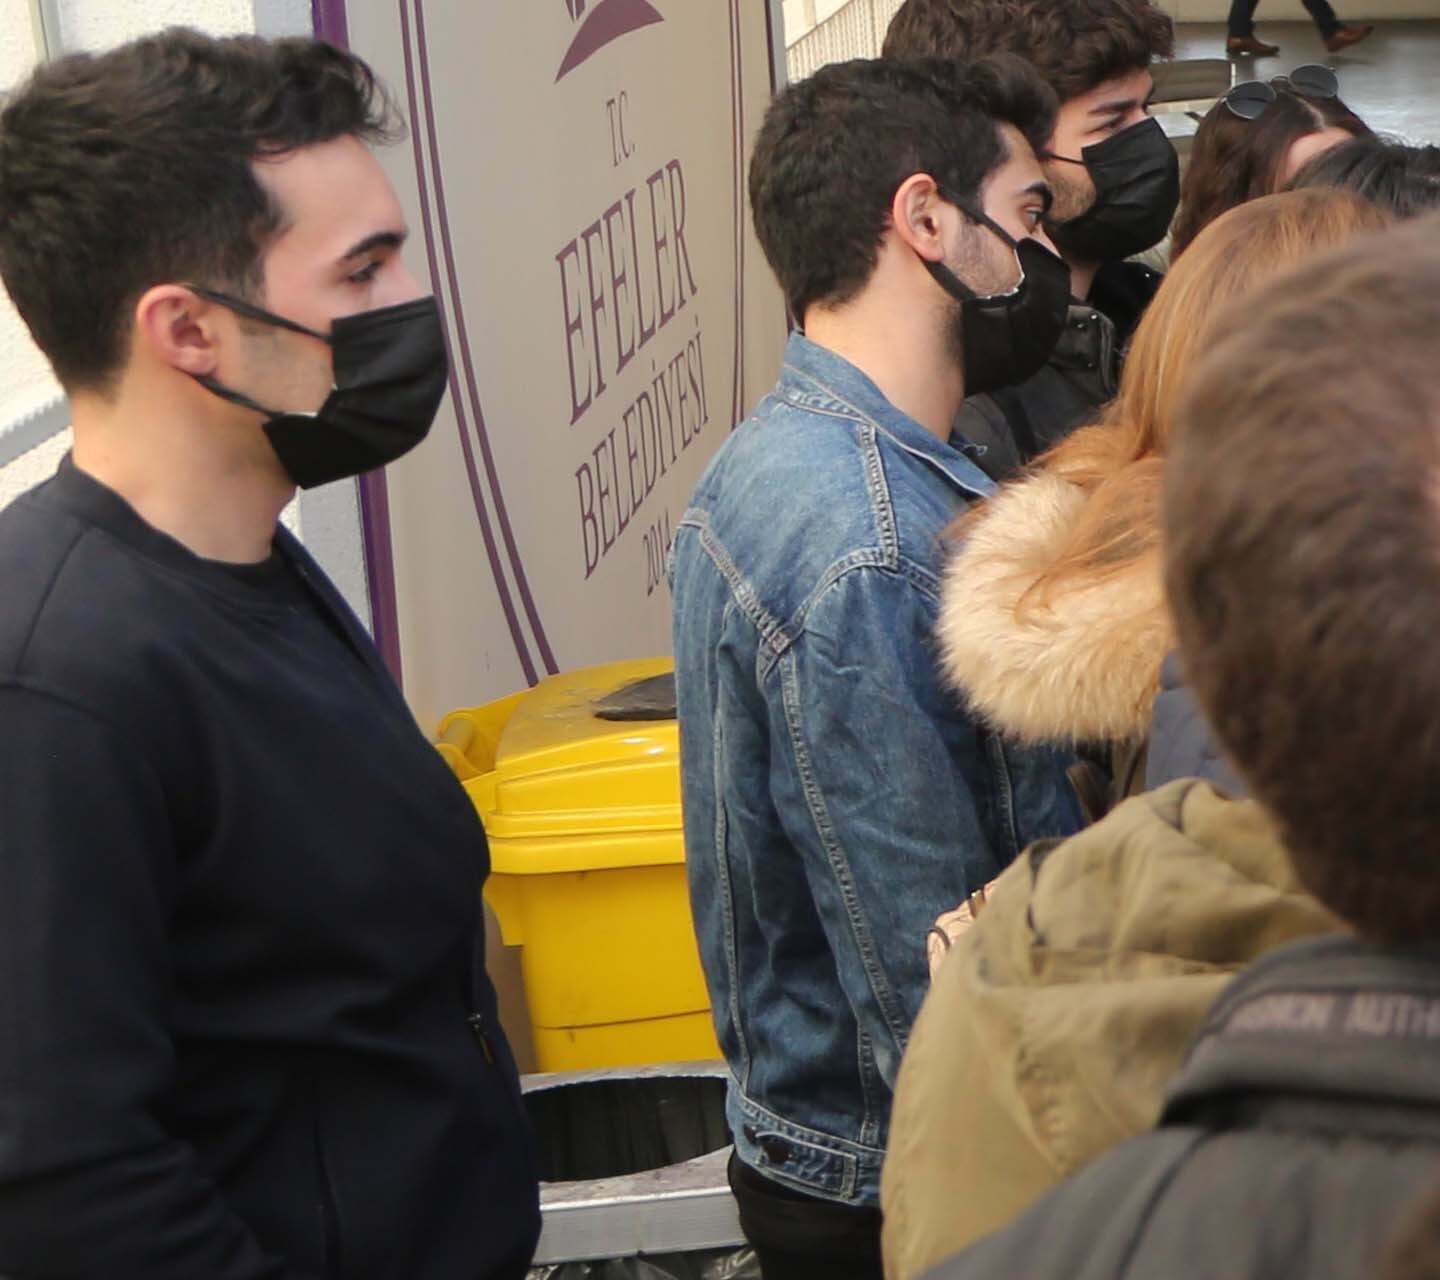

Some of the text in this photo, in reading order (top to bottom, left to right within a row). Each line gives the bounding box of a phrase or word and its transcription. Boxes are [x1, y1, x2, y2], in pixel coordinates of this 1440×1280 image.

[605, 89, 637, 169] T.C.
[554, 157, 698, 427] EFELER
[574, 314, 710, 581] BELEDİYESİ
